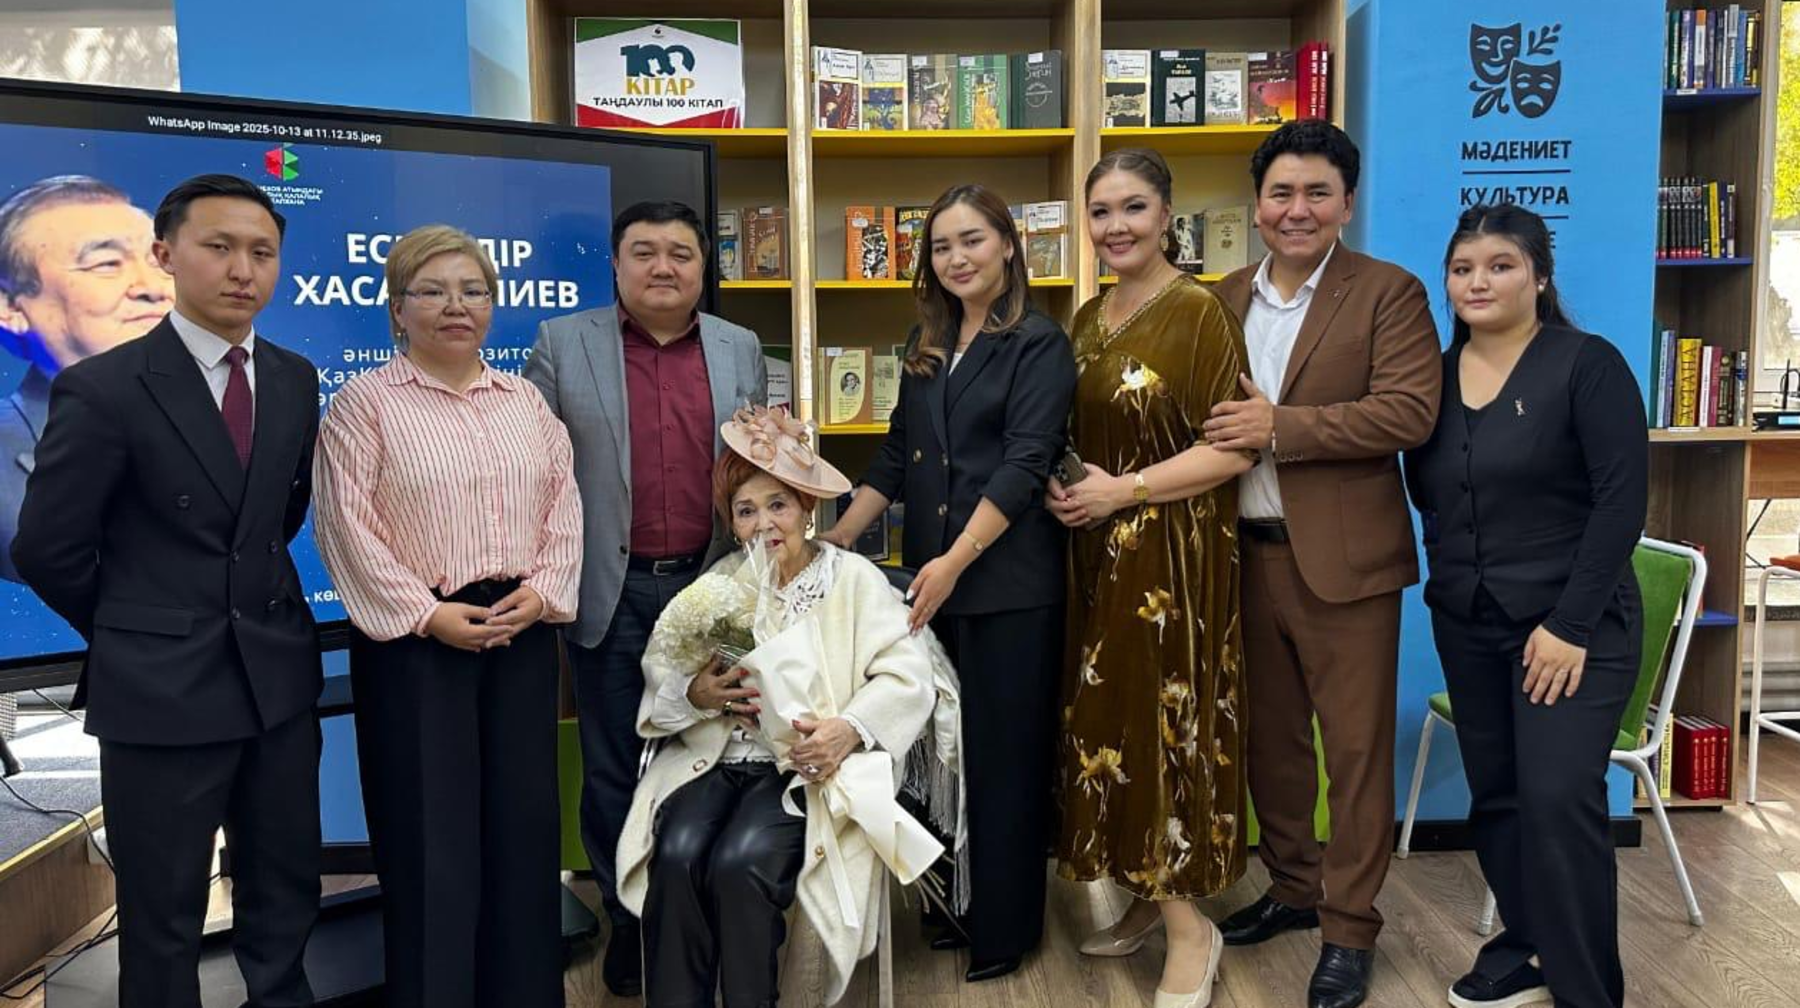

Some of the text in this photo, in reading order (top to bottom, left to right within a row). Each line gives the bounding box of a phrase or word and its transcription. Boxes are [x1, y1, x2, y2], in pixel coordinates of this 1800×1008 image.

[620, 44, 695, 77] 100
[593, 97, 723, 108] ТАҢДАУЛЫ 100 КІТАП
[148, 116, 205, 131] WhatsApp
[207, 120, 240, 133] Image
[242, 123, 300, 136] 2025-10-13
[303, 128, 314, 137] at
[1462, 140, 1572, 162] МӘДЕНИЕТ
[1461, 186, 1569, 206] КУЛЬТУРА
